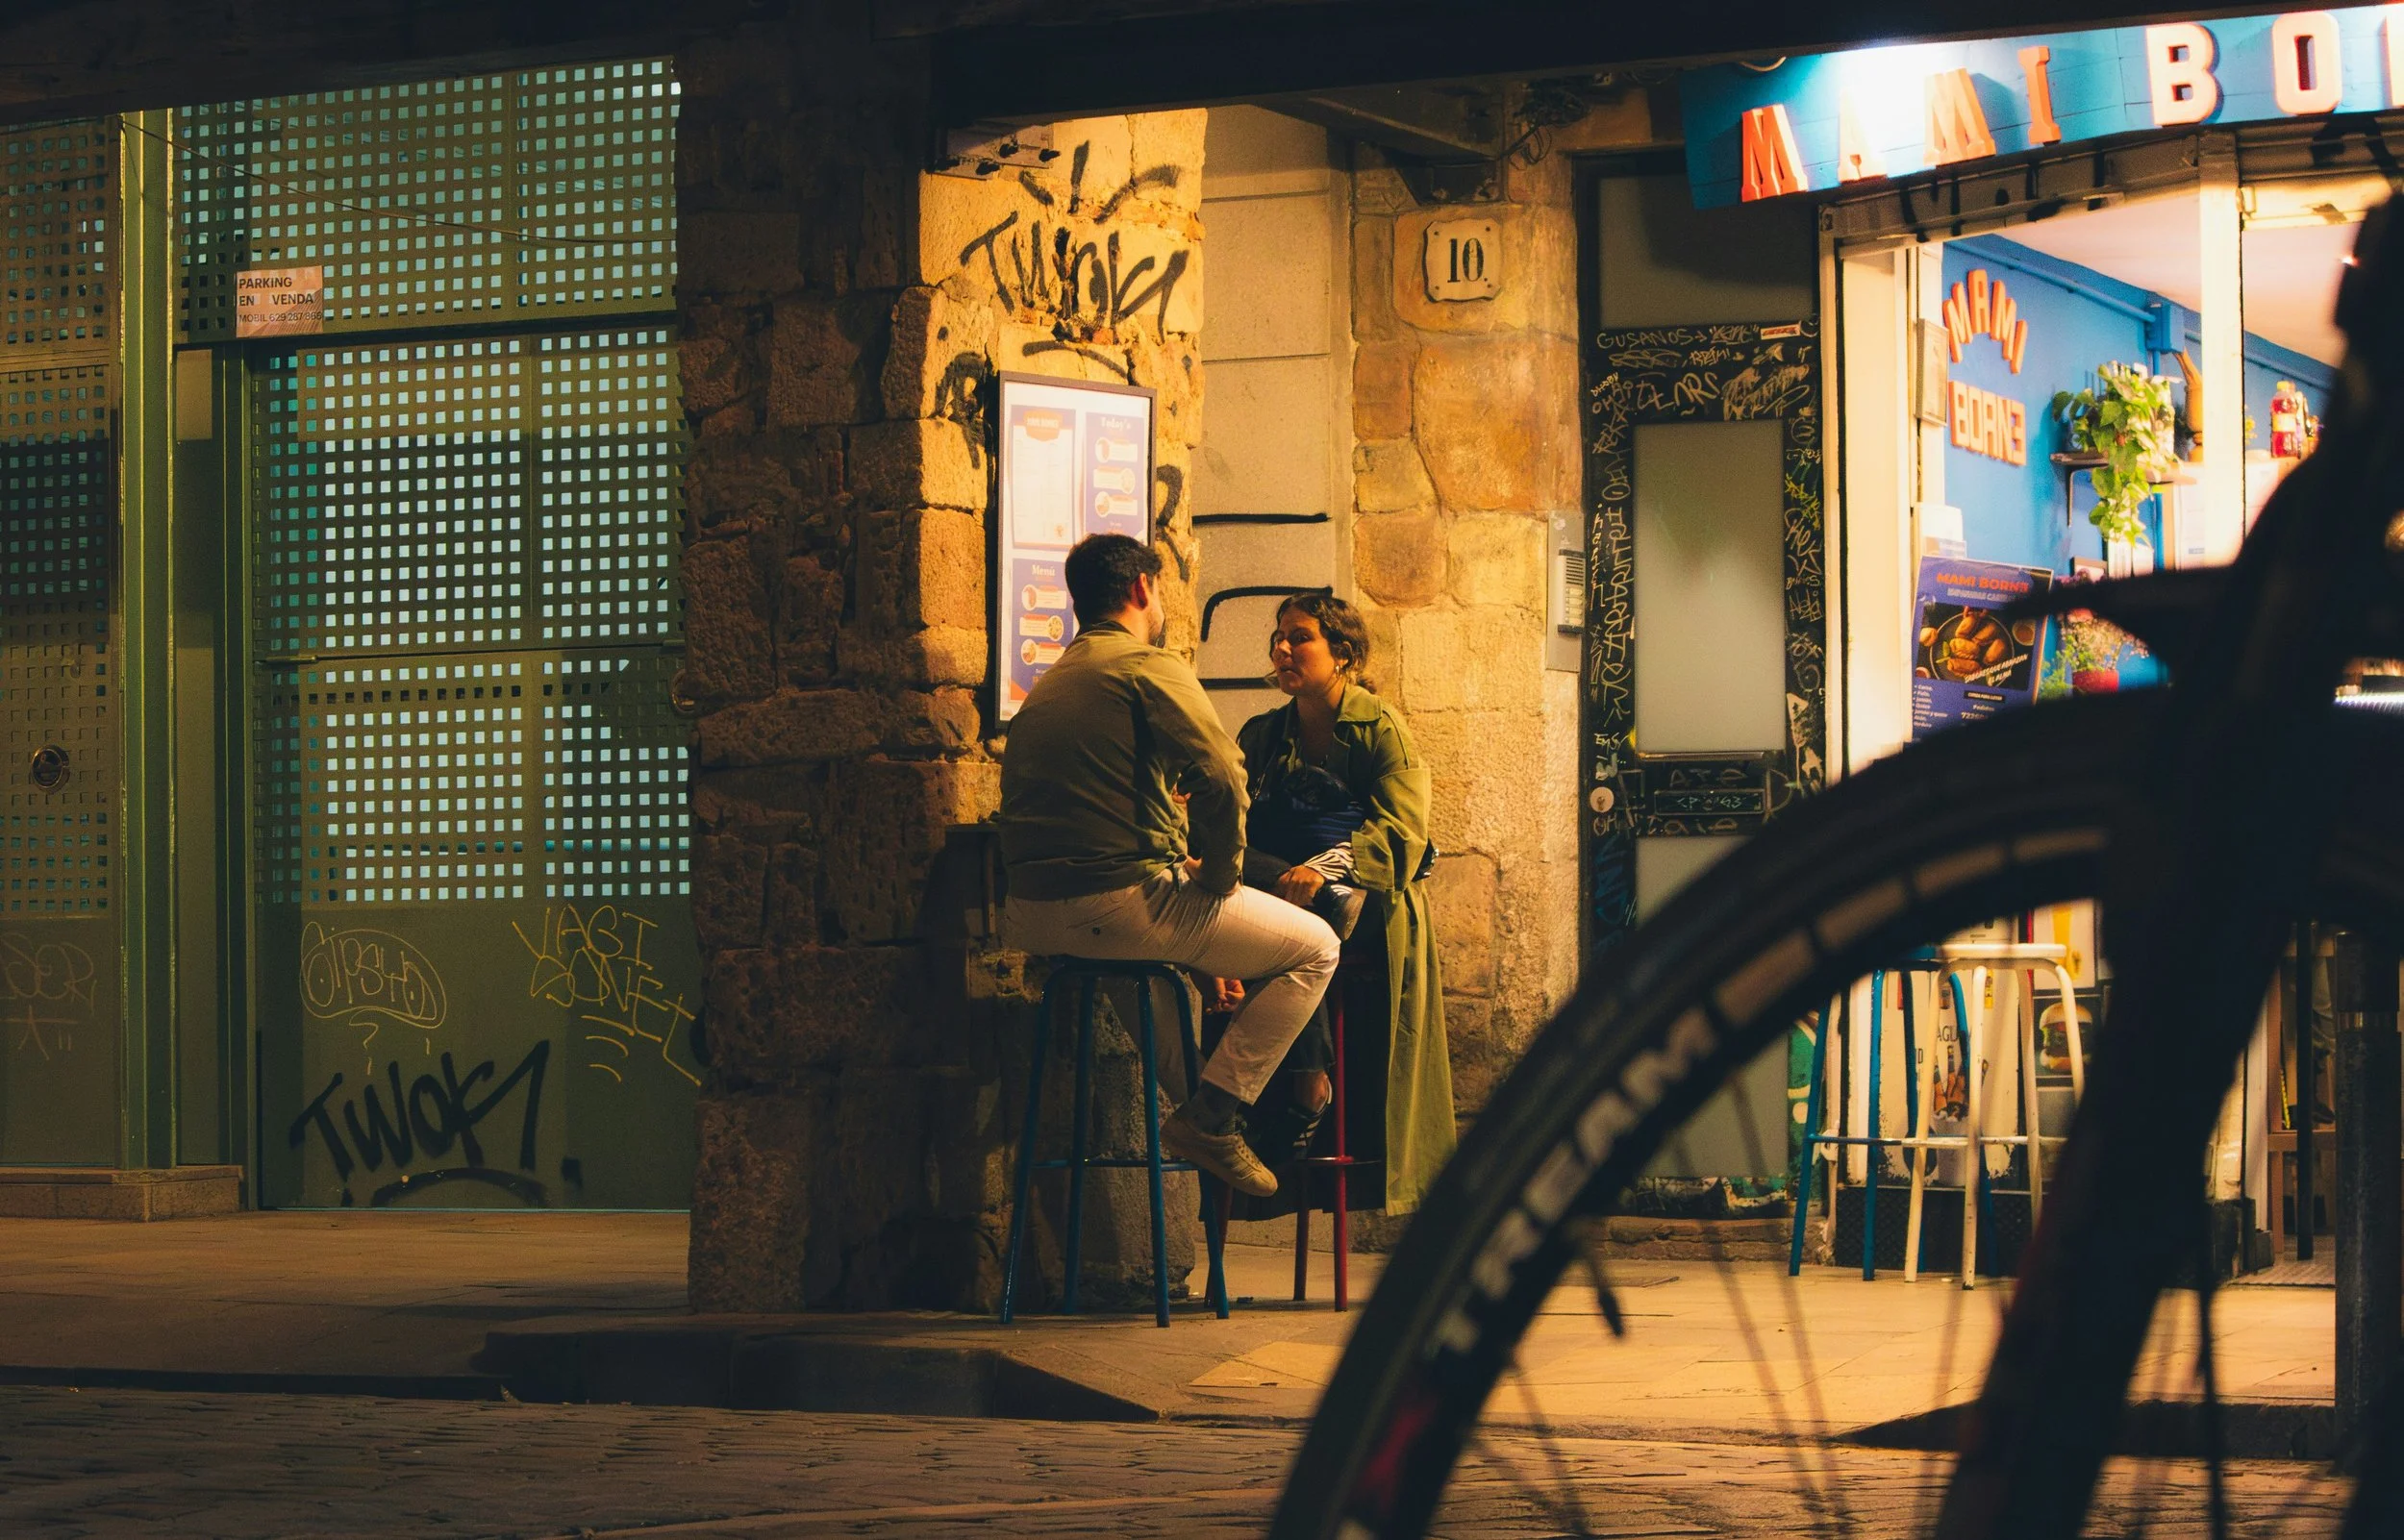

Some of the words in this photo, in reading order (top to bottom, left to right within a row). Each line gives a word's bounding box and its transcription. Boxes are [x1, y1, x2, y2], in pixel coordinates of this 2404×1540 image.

[1740, 45, 2062, 203] MAMI
[1447, 237, 1485, 283] 10
[238, 276, 293, 289] PARKING
[238, 295, 256, 307] EN
[272, 293, 314, 306] VENDA
[238, 313, 267, 323] MOBIL
[1942, 268, 2028, 375] MAMI
